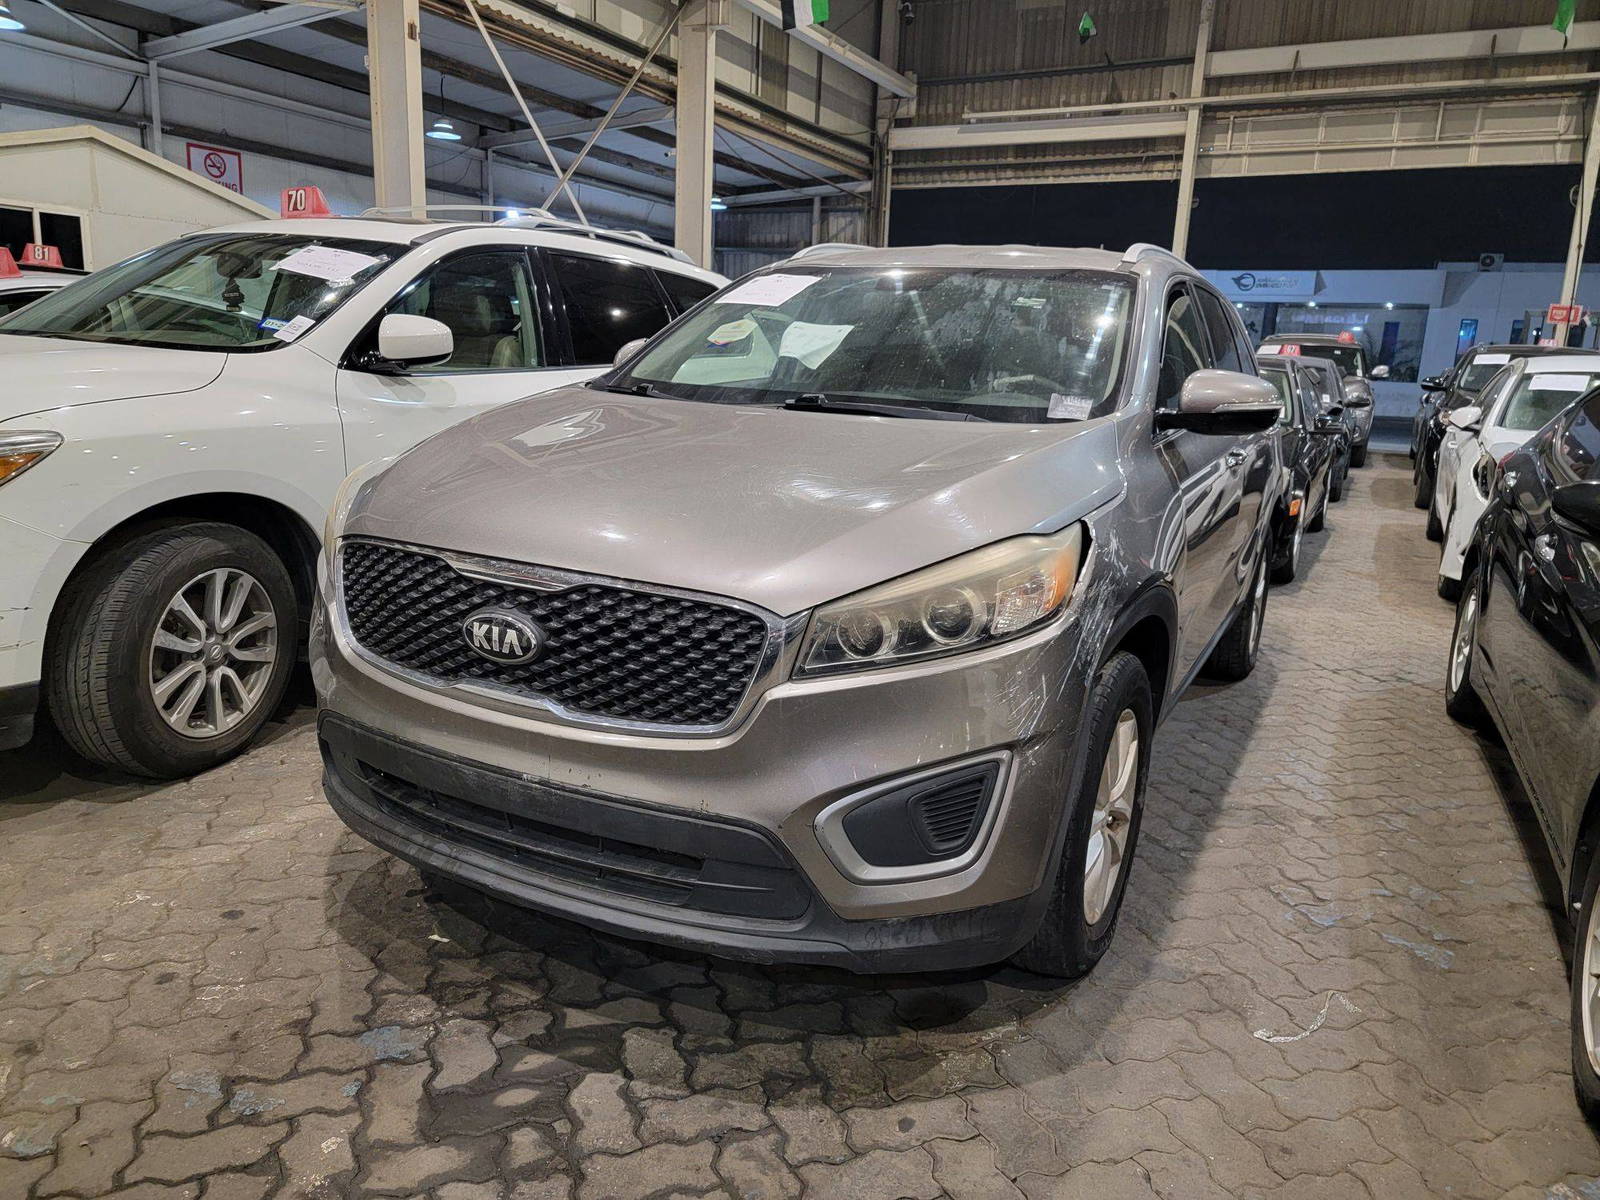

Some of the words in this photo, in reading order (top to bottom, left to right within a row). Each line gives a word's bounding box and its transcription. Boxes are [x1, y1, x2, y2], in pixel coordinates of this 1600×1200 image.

[288, 190, 305, 211] 70
[35, 246, 48, 261] 81
[473, 621, 523, 656] KIA
